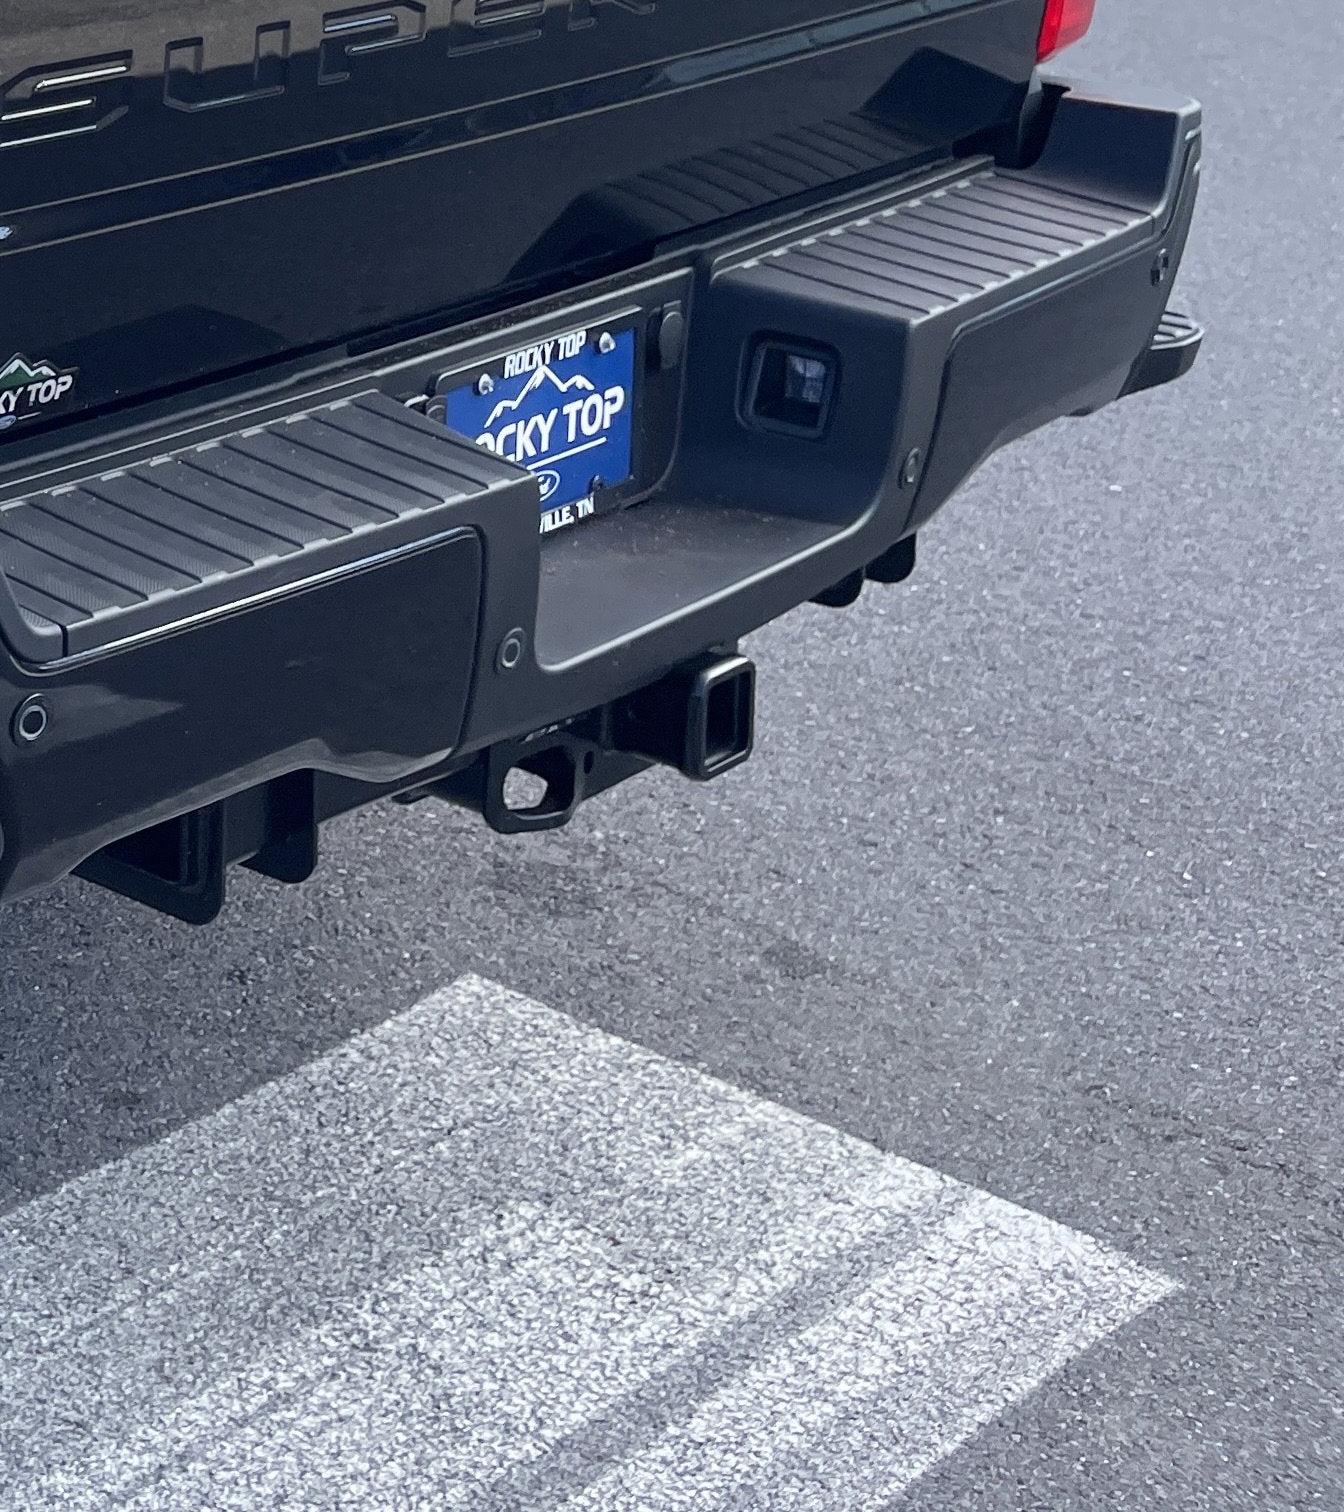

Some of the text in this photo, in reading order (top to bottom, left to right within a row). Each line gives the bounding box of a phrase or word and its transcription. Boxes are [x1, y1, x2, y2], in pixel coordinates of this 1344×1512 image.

[504, 330, 587, 379] ROCKY TOP
[27, 375, 73, 406] TOP
[475, 386, 625, 462] OCKY TOP
[576, 496, 594, 519] TN
